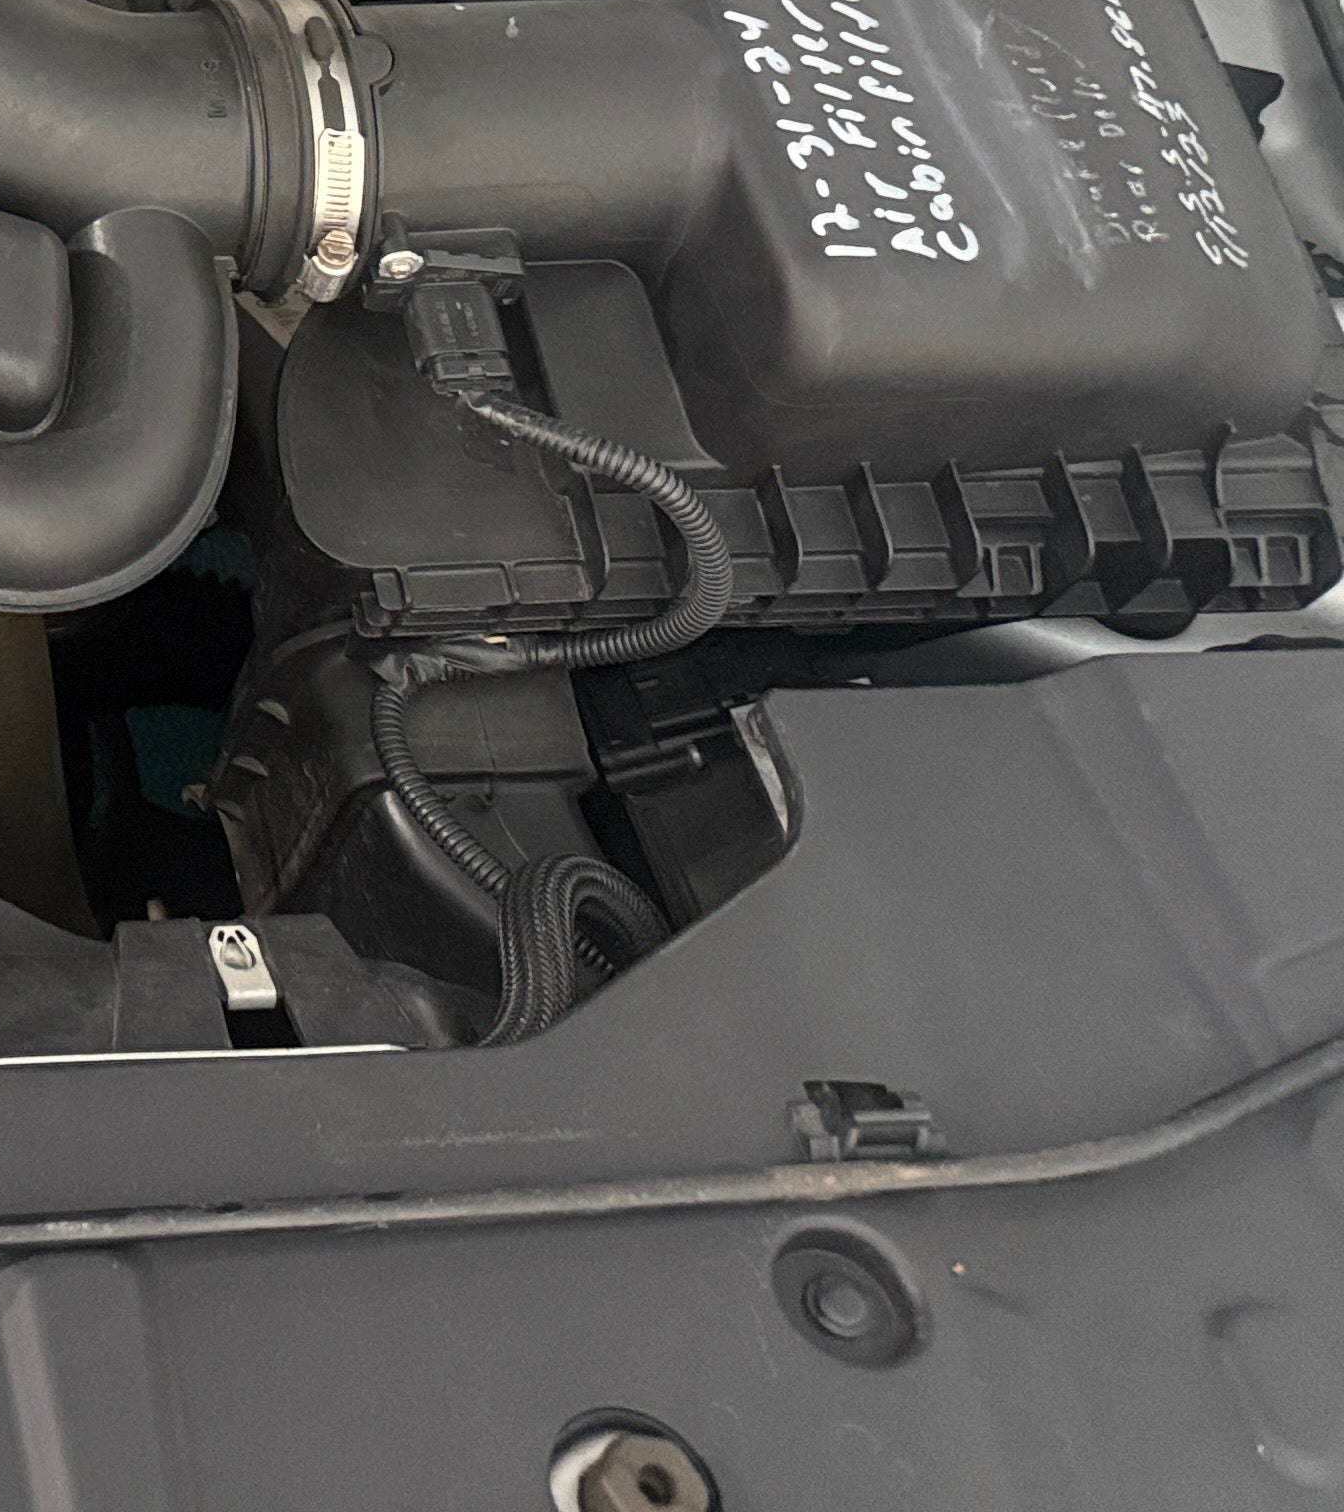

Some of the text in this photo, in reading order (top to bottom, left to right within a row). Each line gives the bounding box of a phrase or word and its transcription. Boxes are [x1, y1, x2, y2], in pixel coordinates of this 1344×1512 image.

[723, 9, 878, 257] 12-31-24
[891, 116, 980, 262] Cabin
[864, 171, 940, 259] Air
